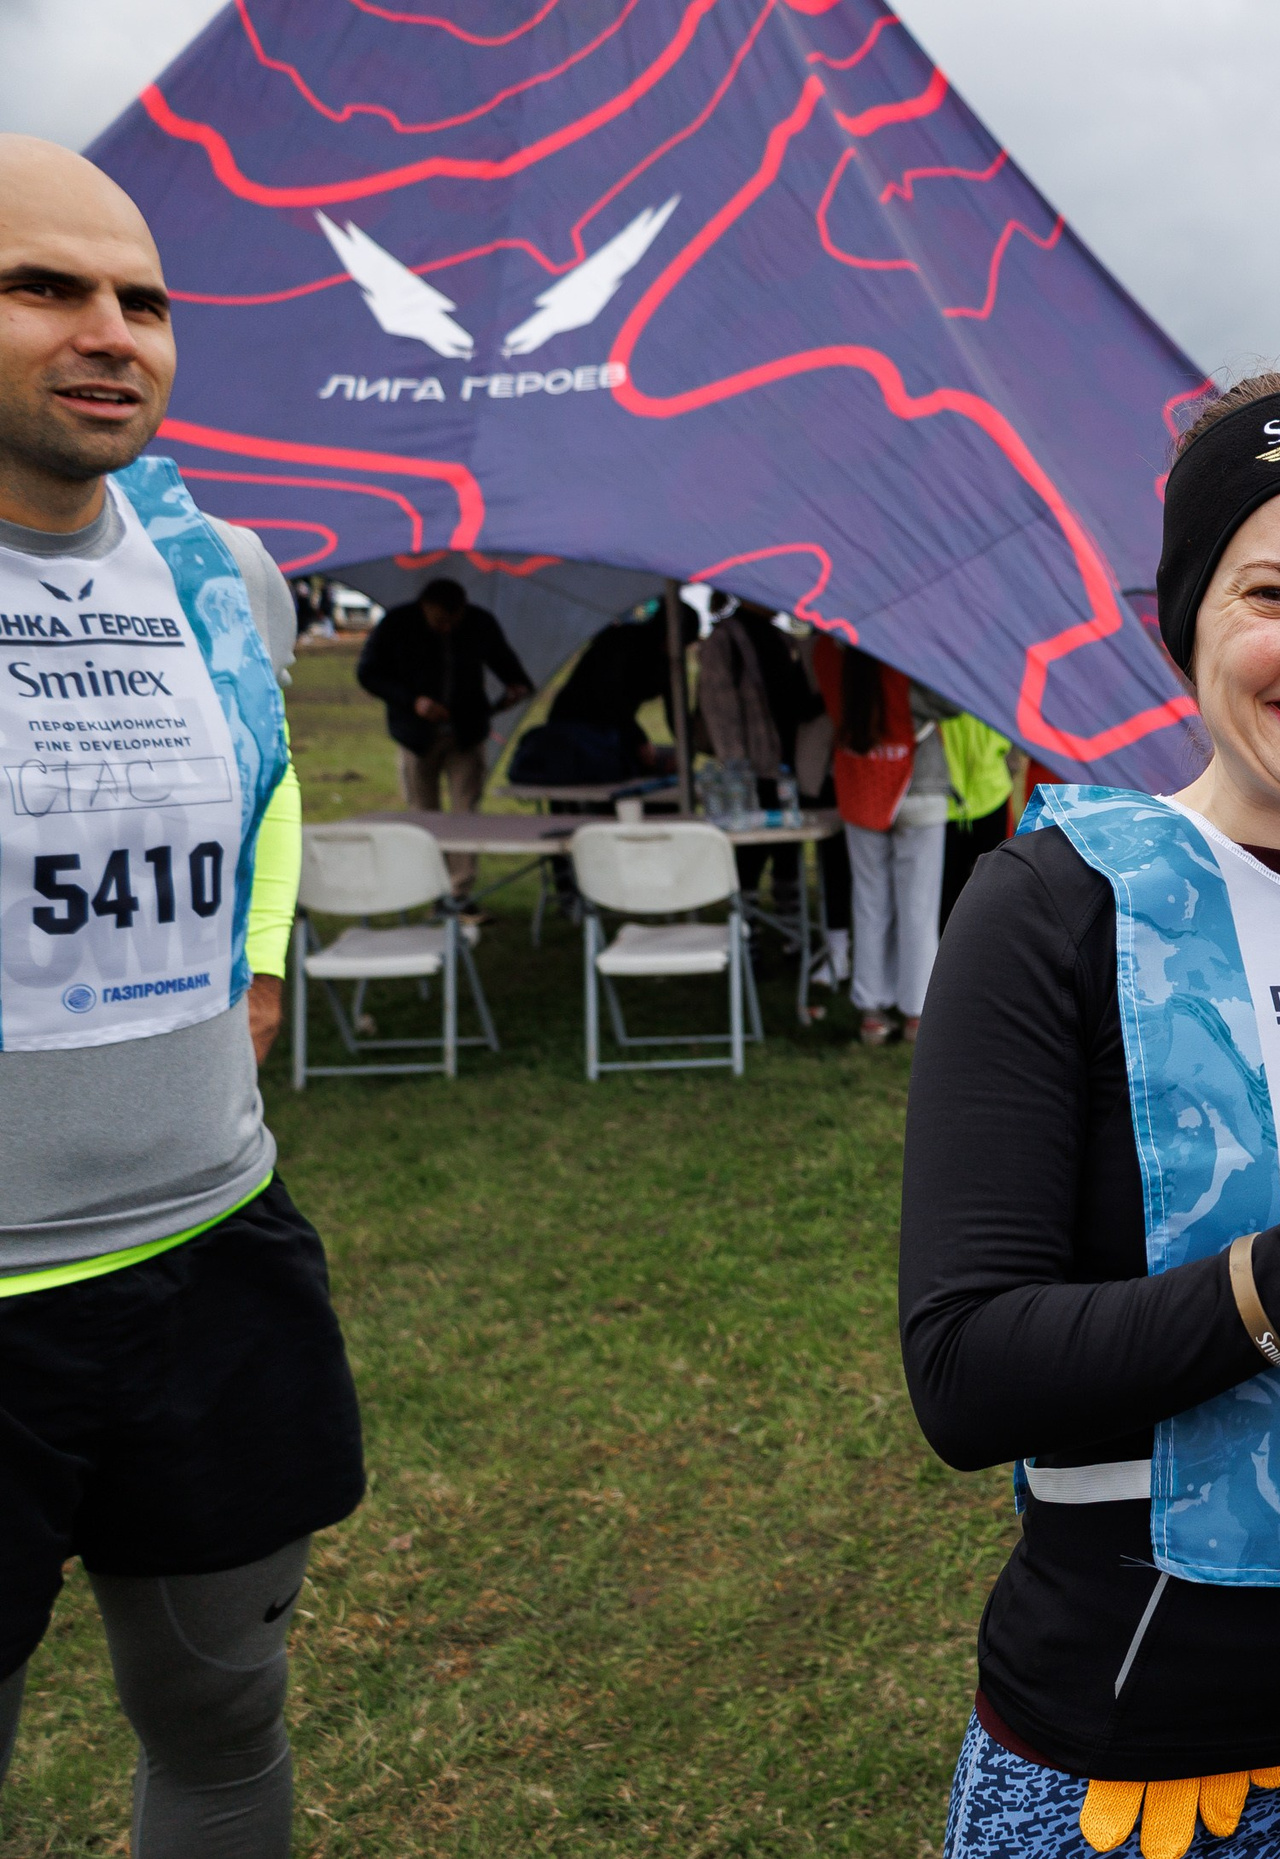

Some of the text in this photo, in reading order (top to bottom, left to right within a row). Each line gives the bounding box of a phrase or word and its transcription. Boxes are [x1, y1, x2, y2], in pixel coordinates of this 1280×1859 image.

[318, 362, 628, 402] ЛИГА ГЕРОЕВ
[0, 613, 182, 638] НКА ГЕРОЕВ
[7, 660, 173, 699] Sminex
[28, 717, 188, 734] ПЕРФЕКЦИОНИСТЫ
[34, 735, 192, 753] FINE DEVELOPMENT
[18, 758, 172, 818] СТАС
[32, 841, 224, 935] 5410
[102, 972, 212, 1004] ГАЗПРОМБАНК
